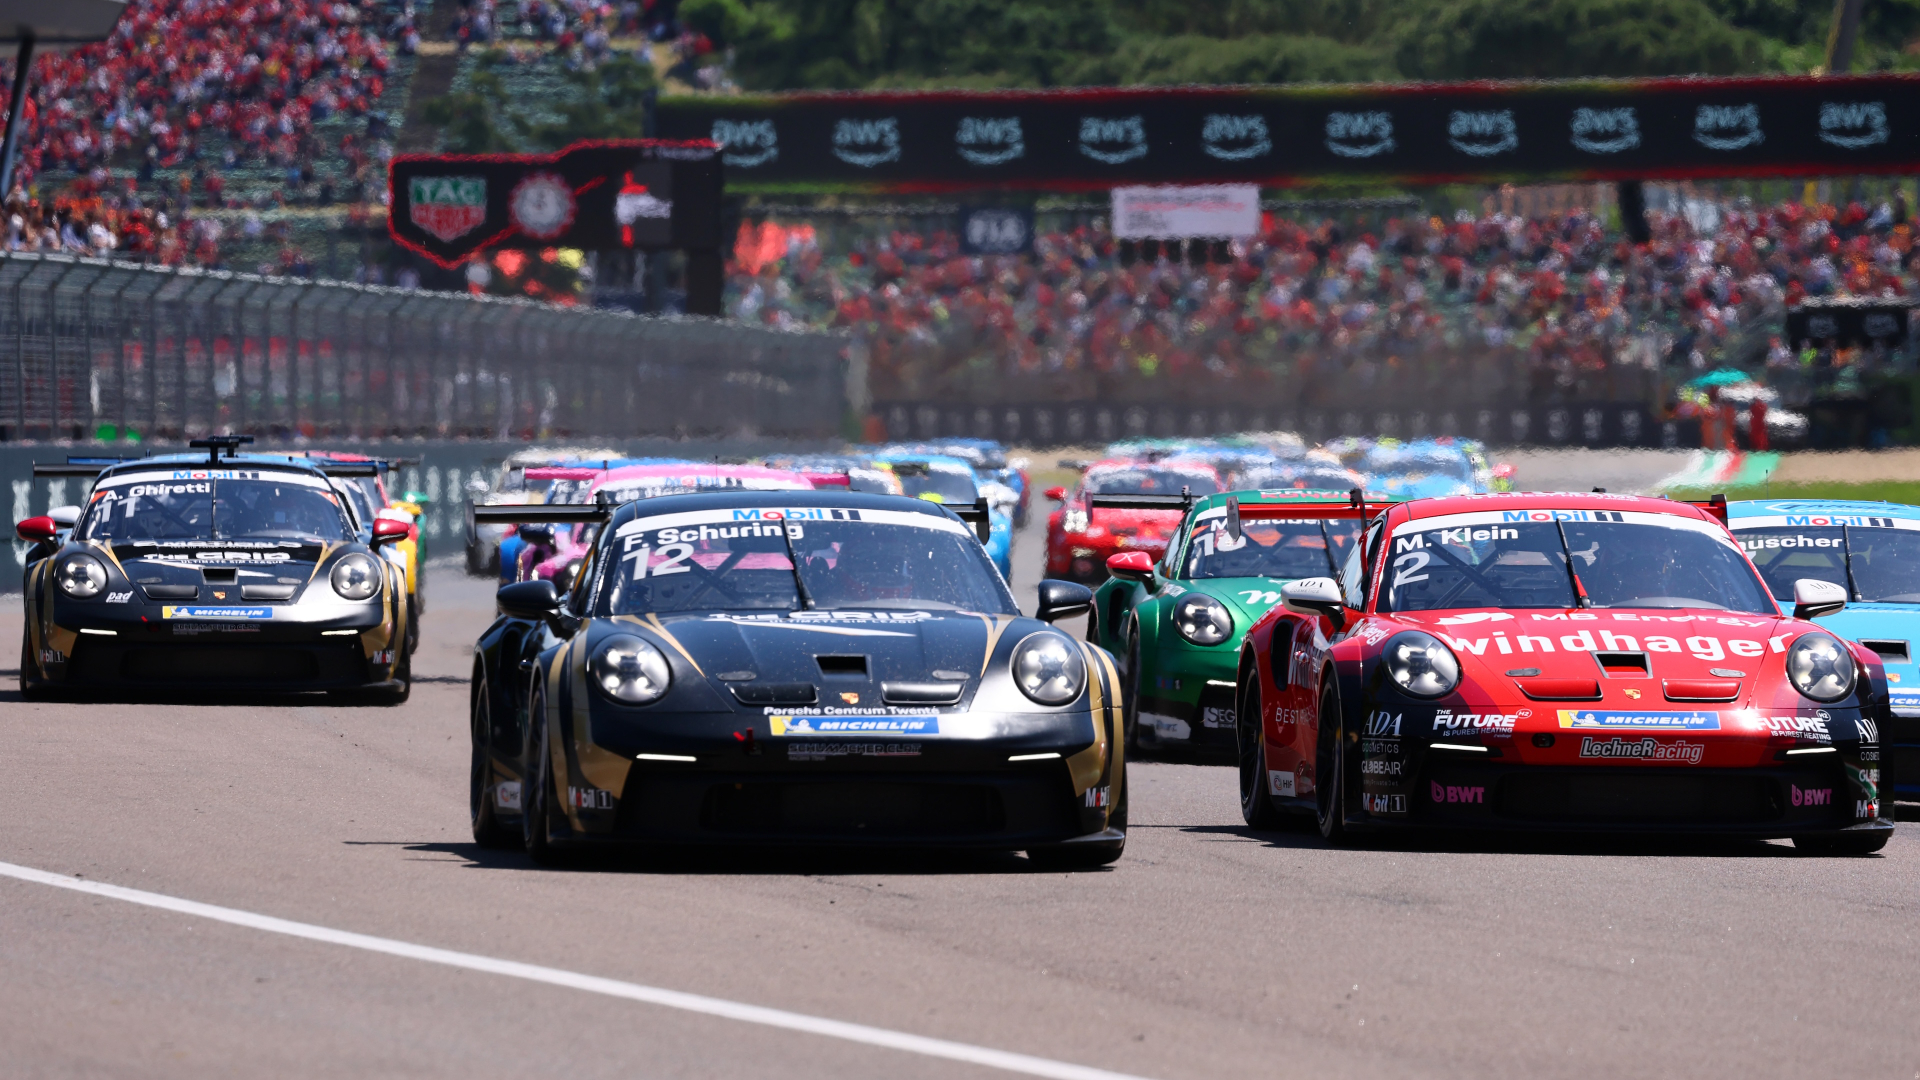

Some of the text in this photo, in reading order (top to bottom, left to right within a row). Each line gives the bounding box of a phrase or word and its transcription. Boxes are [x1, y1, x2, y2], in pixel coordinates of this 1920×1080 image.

[173, 471, 233, 479] Mobil
[102, 483, 210, 501] A. Ghiretti
[94, 497, 140, 523] 11
[733, 508, 824, 521] Mobil
[1503, 511, 1588, 522] Mobil
[1786, 516, 1863, 526] Mobil
[624, 522, 804, 552] F. Schuring
[1396, 526, 1518, 554] M. Klein
[196, 552, 290, 560] GRID
[622, 543, 695, 581] 12
[1393, 551, 1430, 587] 2
[789, 611, 932, 620] GRID
[1531, 612, 1768, 628] MB Energy
[1443, 629, 1794, 661] windhager
[763, 706, 821, 715] Porsche
[824, 706, 886, 715] Centrum
[819, 721, 926, 729] MICHELIN
[1362, 710, 1402, 736] ADA
[1433, 714, 1518, 730] FUTURE
[1605, 715, 1707, 725] MICHELIN
[1757, 716, 1829, 733] FUTURE
[1452, 728, 1480, 736] PUREST
[1804, 732, 1832, 740] HEATING
[787, 743, 885, 753] SCHUMACHER
[1362, 743, 1399, 754] COSMETICS
[1361, 760, 1401, 775] GLOBEAIR
[568, 786, 595, 809] Mobil
[1362, 793, 1388, 812] Mobil
[1447, 786, 1485, 804] BWT
[1804, 788, 1832, 806] BWT
